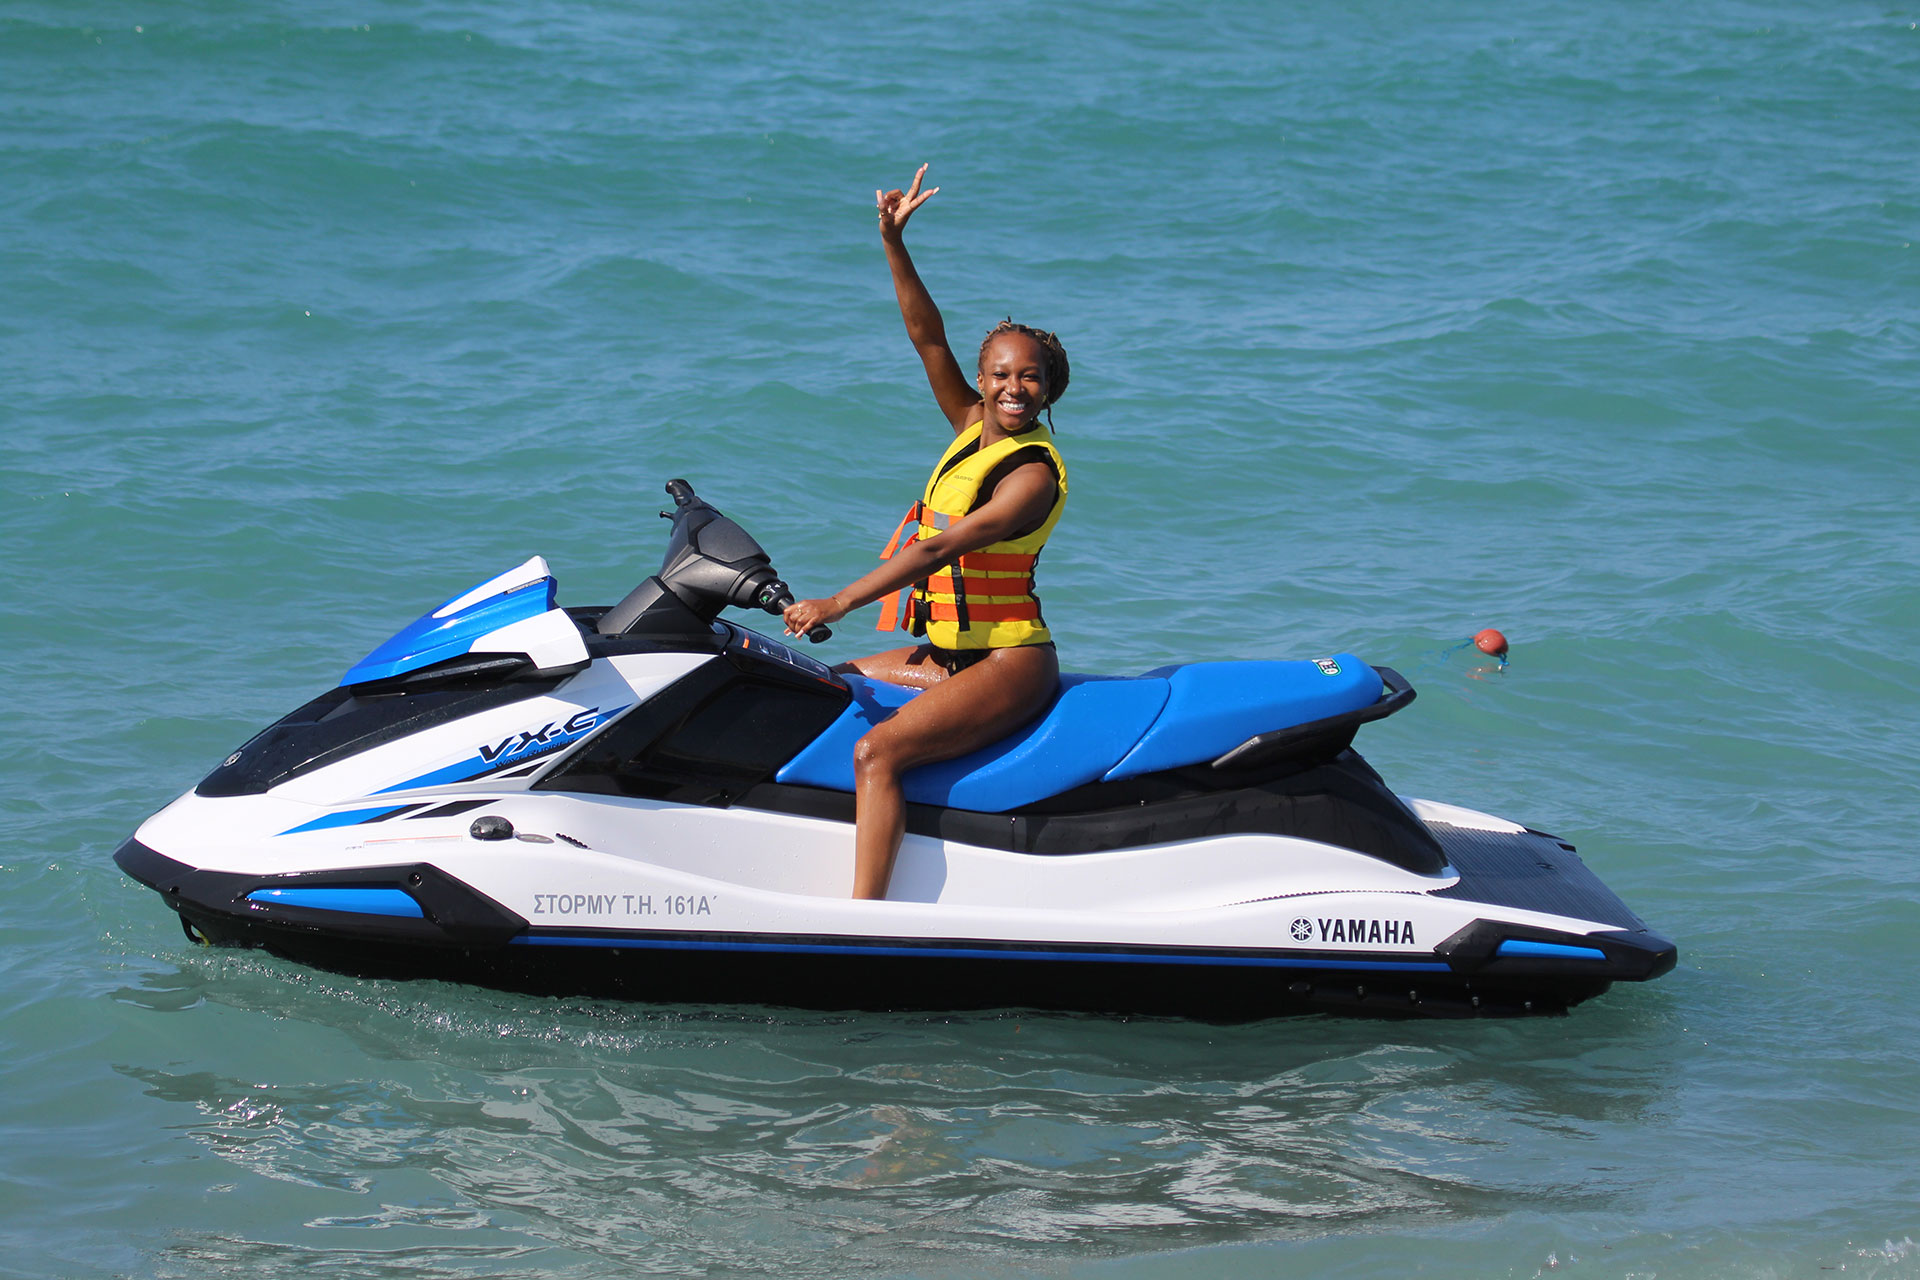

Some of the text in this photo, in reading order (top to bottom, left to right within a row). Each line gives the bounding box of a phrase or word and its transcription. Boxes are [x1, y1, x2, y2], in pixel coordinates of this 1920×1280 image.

[479, 707, 599, 762] VX-C
[533, 894, 617, 914] ΣΤΟΡΜΥ
[1317, 918, 1415, 944] YAMAHA
